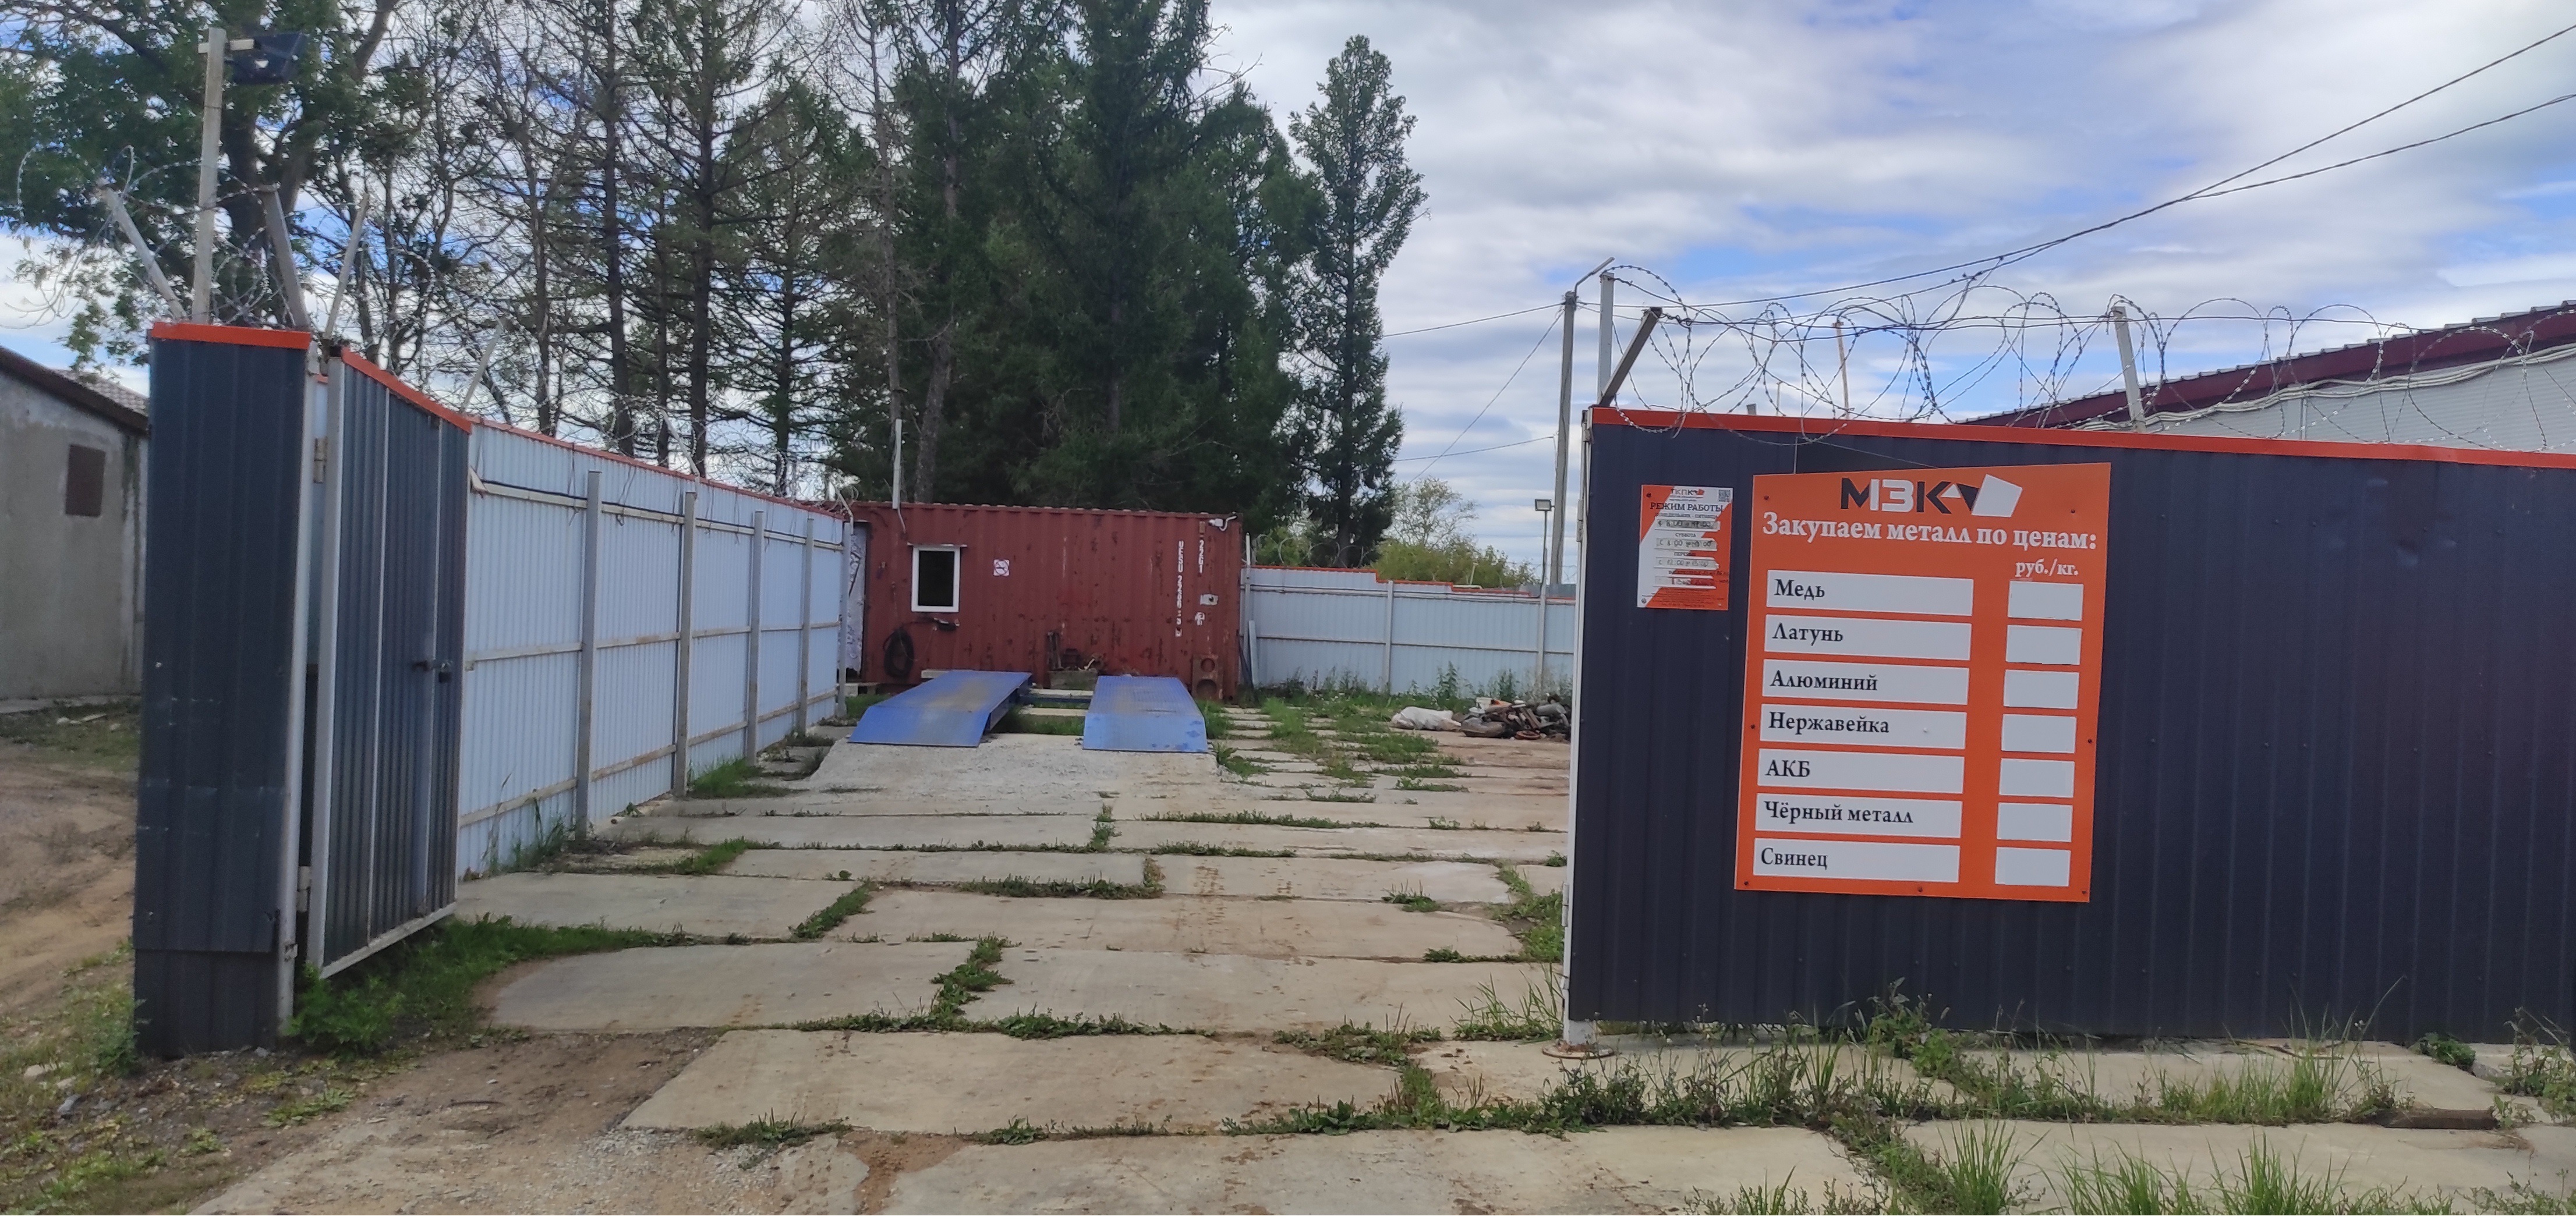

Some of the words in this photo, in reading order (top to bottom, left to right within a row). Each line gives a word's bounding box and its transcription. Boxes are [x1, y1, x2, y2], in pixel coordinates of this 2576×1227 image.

[1650, 502, 1685, 511] РЕЖИМ
[1687, 503, 1724, 512] РАБОТЫ
[1763, 512, 1883, 543] Закупаем
[1886, 524, 1973, 544] металл
[1976, 528, 2008, 545] по
[2012, 530, 2096, 551] ценам:
[2015, 558, 2079, 577] руб./кг.
[1774, 579, 1825, 600] Медь
[1772, 623, 1844, 646] Латунь
[1770, 669, 1878, 691] Алюминий
[1768, 711, 1889, 734] Нержавейка
[1765, 760, 1811, 778] АКБ
[1764, 801, 1842, 824] Чёрный
[1847, 807, 1913, 824] металл
[1761, 847, 1828, 870] Свинец
